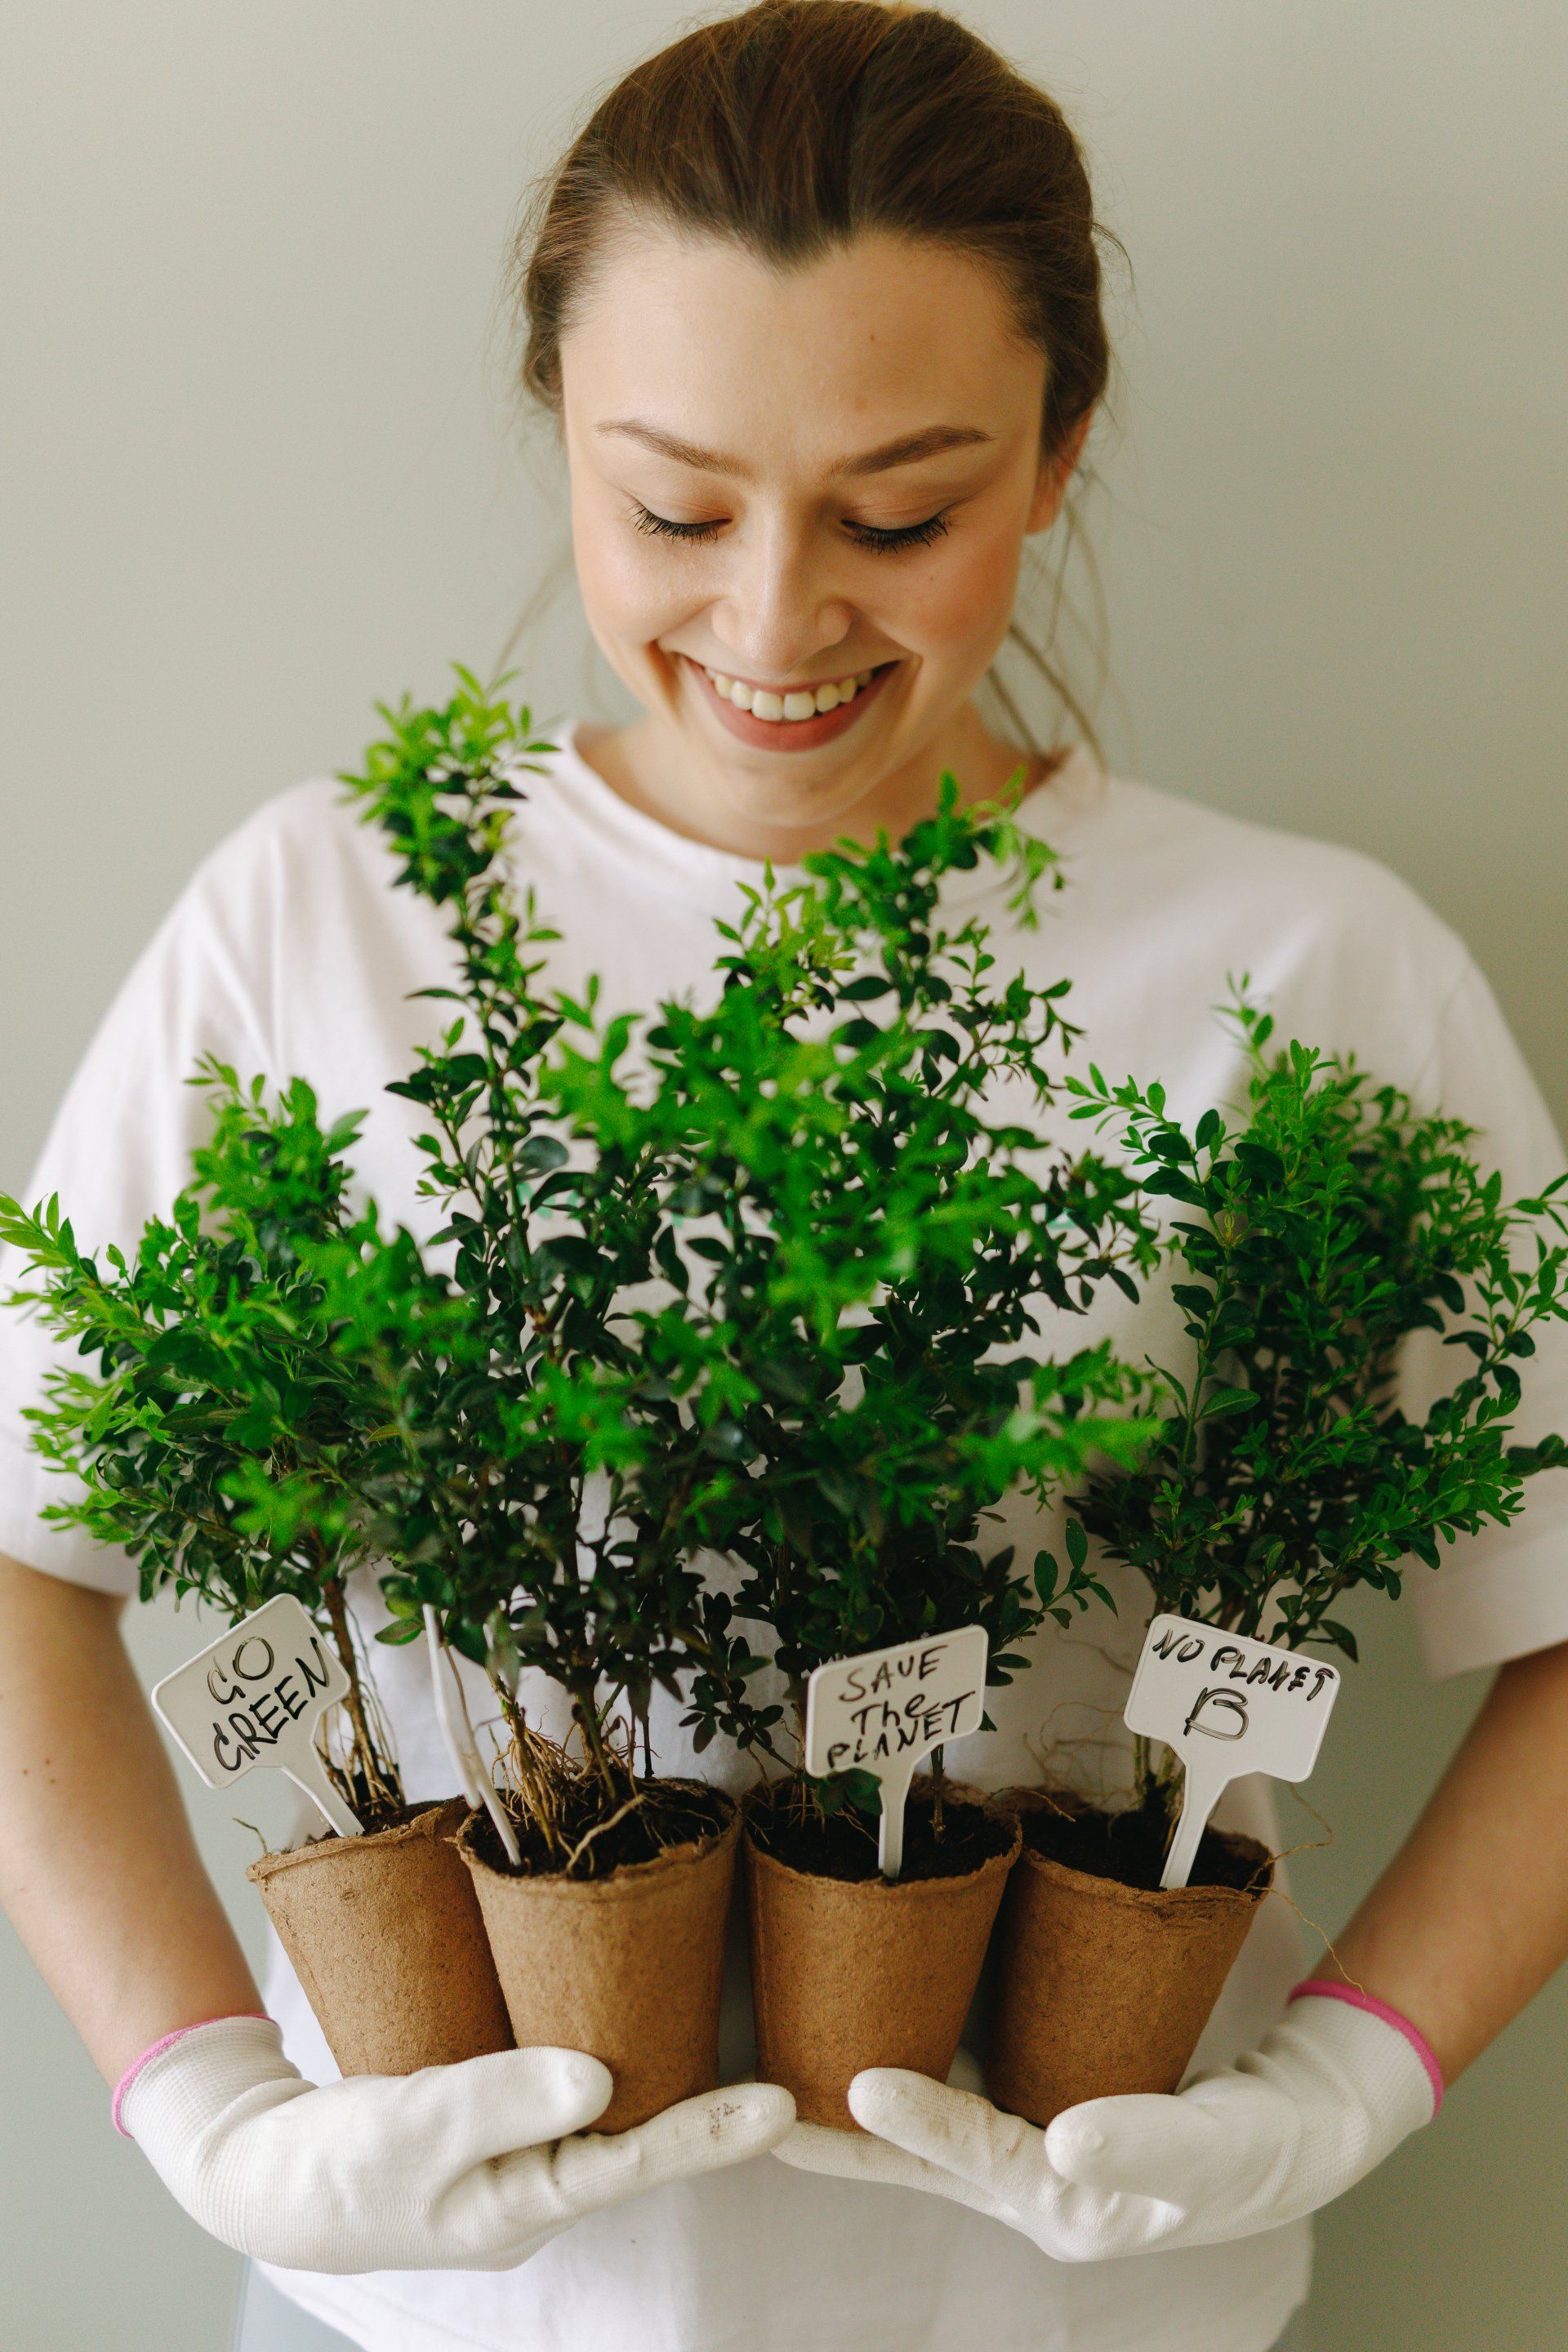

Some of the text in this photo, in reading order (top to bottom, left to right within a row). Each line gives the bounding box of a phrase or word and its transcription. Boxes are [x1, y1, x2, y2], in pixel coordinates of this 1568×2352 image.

[207, 1636, 274, 1704] GO
[839, 1645, 948, 1702] SAVE
[1152, 1628, 1335, 1702] NO PLANET
[212, 1637, 330, 1771] GREEN
[827, 1690, 976, 1768] PLANET
[1183, 1686, 1250, 1741] B
